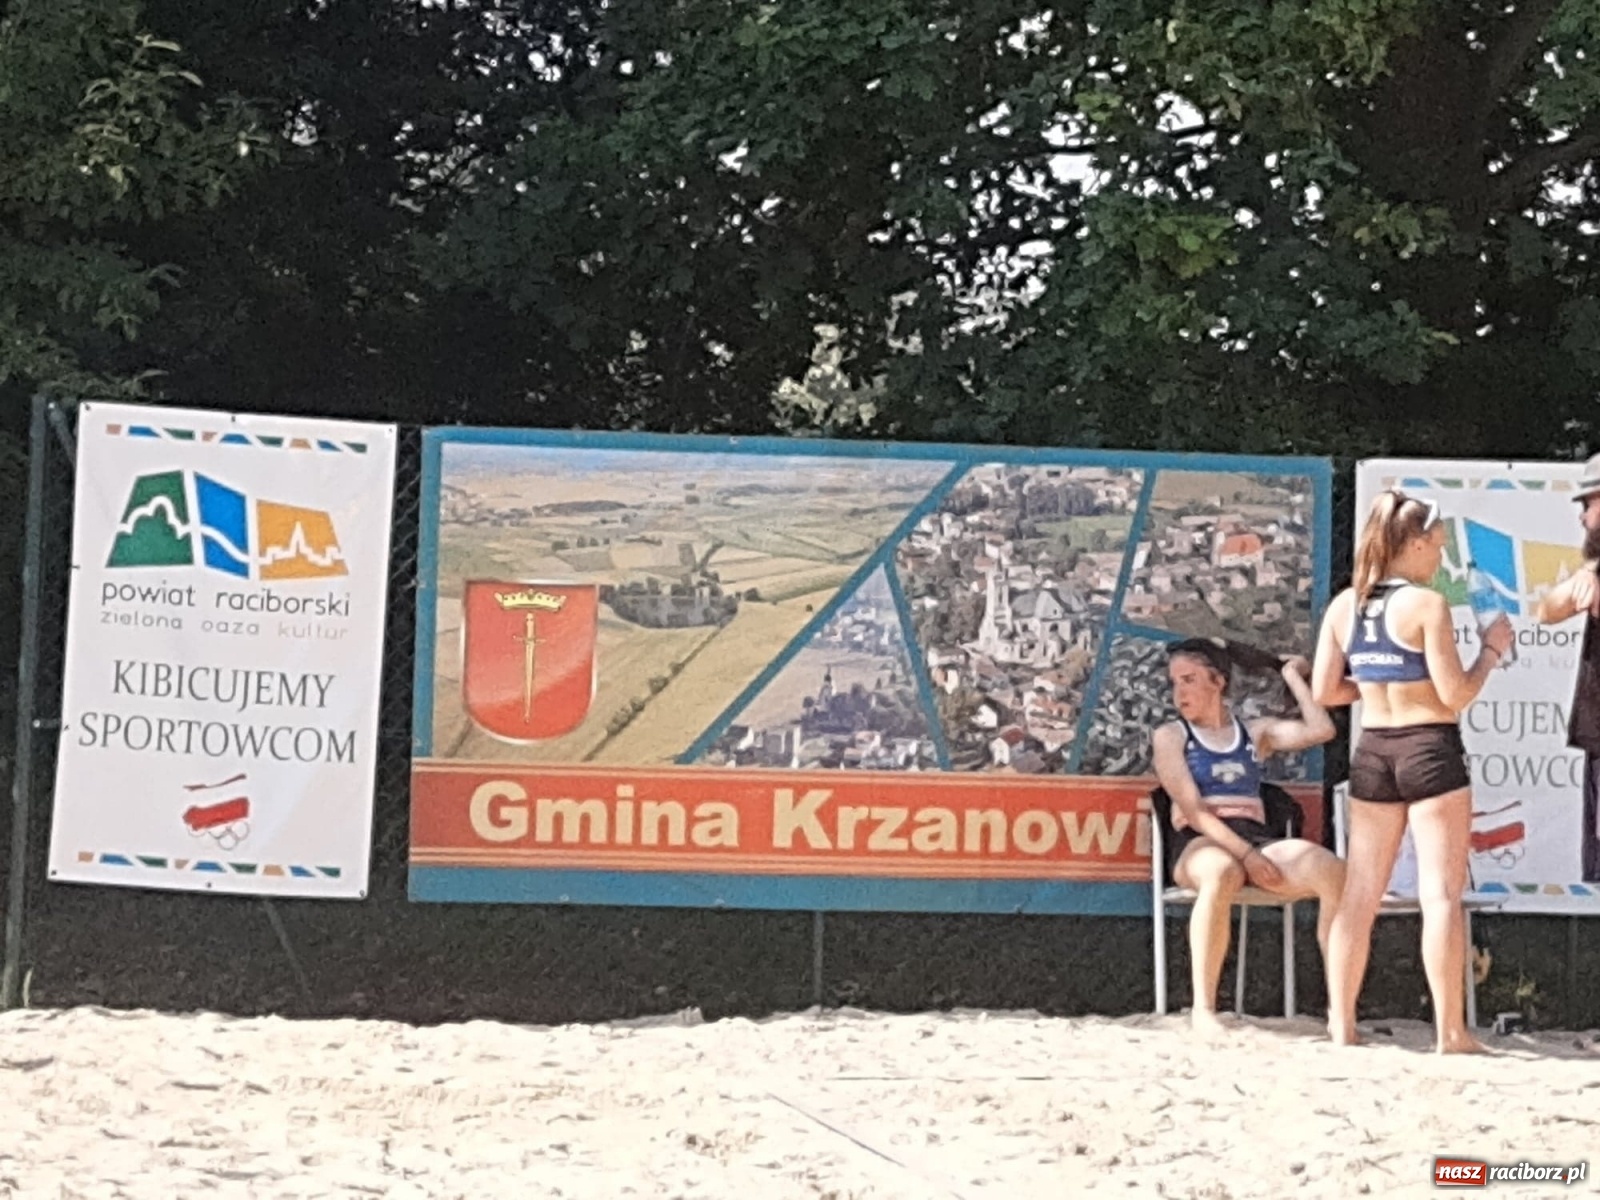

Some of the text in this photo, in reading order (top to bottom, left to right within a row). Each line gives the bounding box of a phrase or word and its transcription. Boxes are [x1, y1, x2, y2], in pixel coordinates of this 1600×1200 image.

[101, 579, 350, 617] powiat raciborski
[100, 608, 349, 640] zielona oaza kultur
[1363, 619, 1378, 643] 1
[1518, 623, 1580, 647] cibor
[112, 659, 336, 712] KIBICUJEMY
[78, 711, 357, 764] SPORTOWCOM
[469, 780, 1152, 857] Gmina Krzanowi
